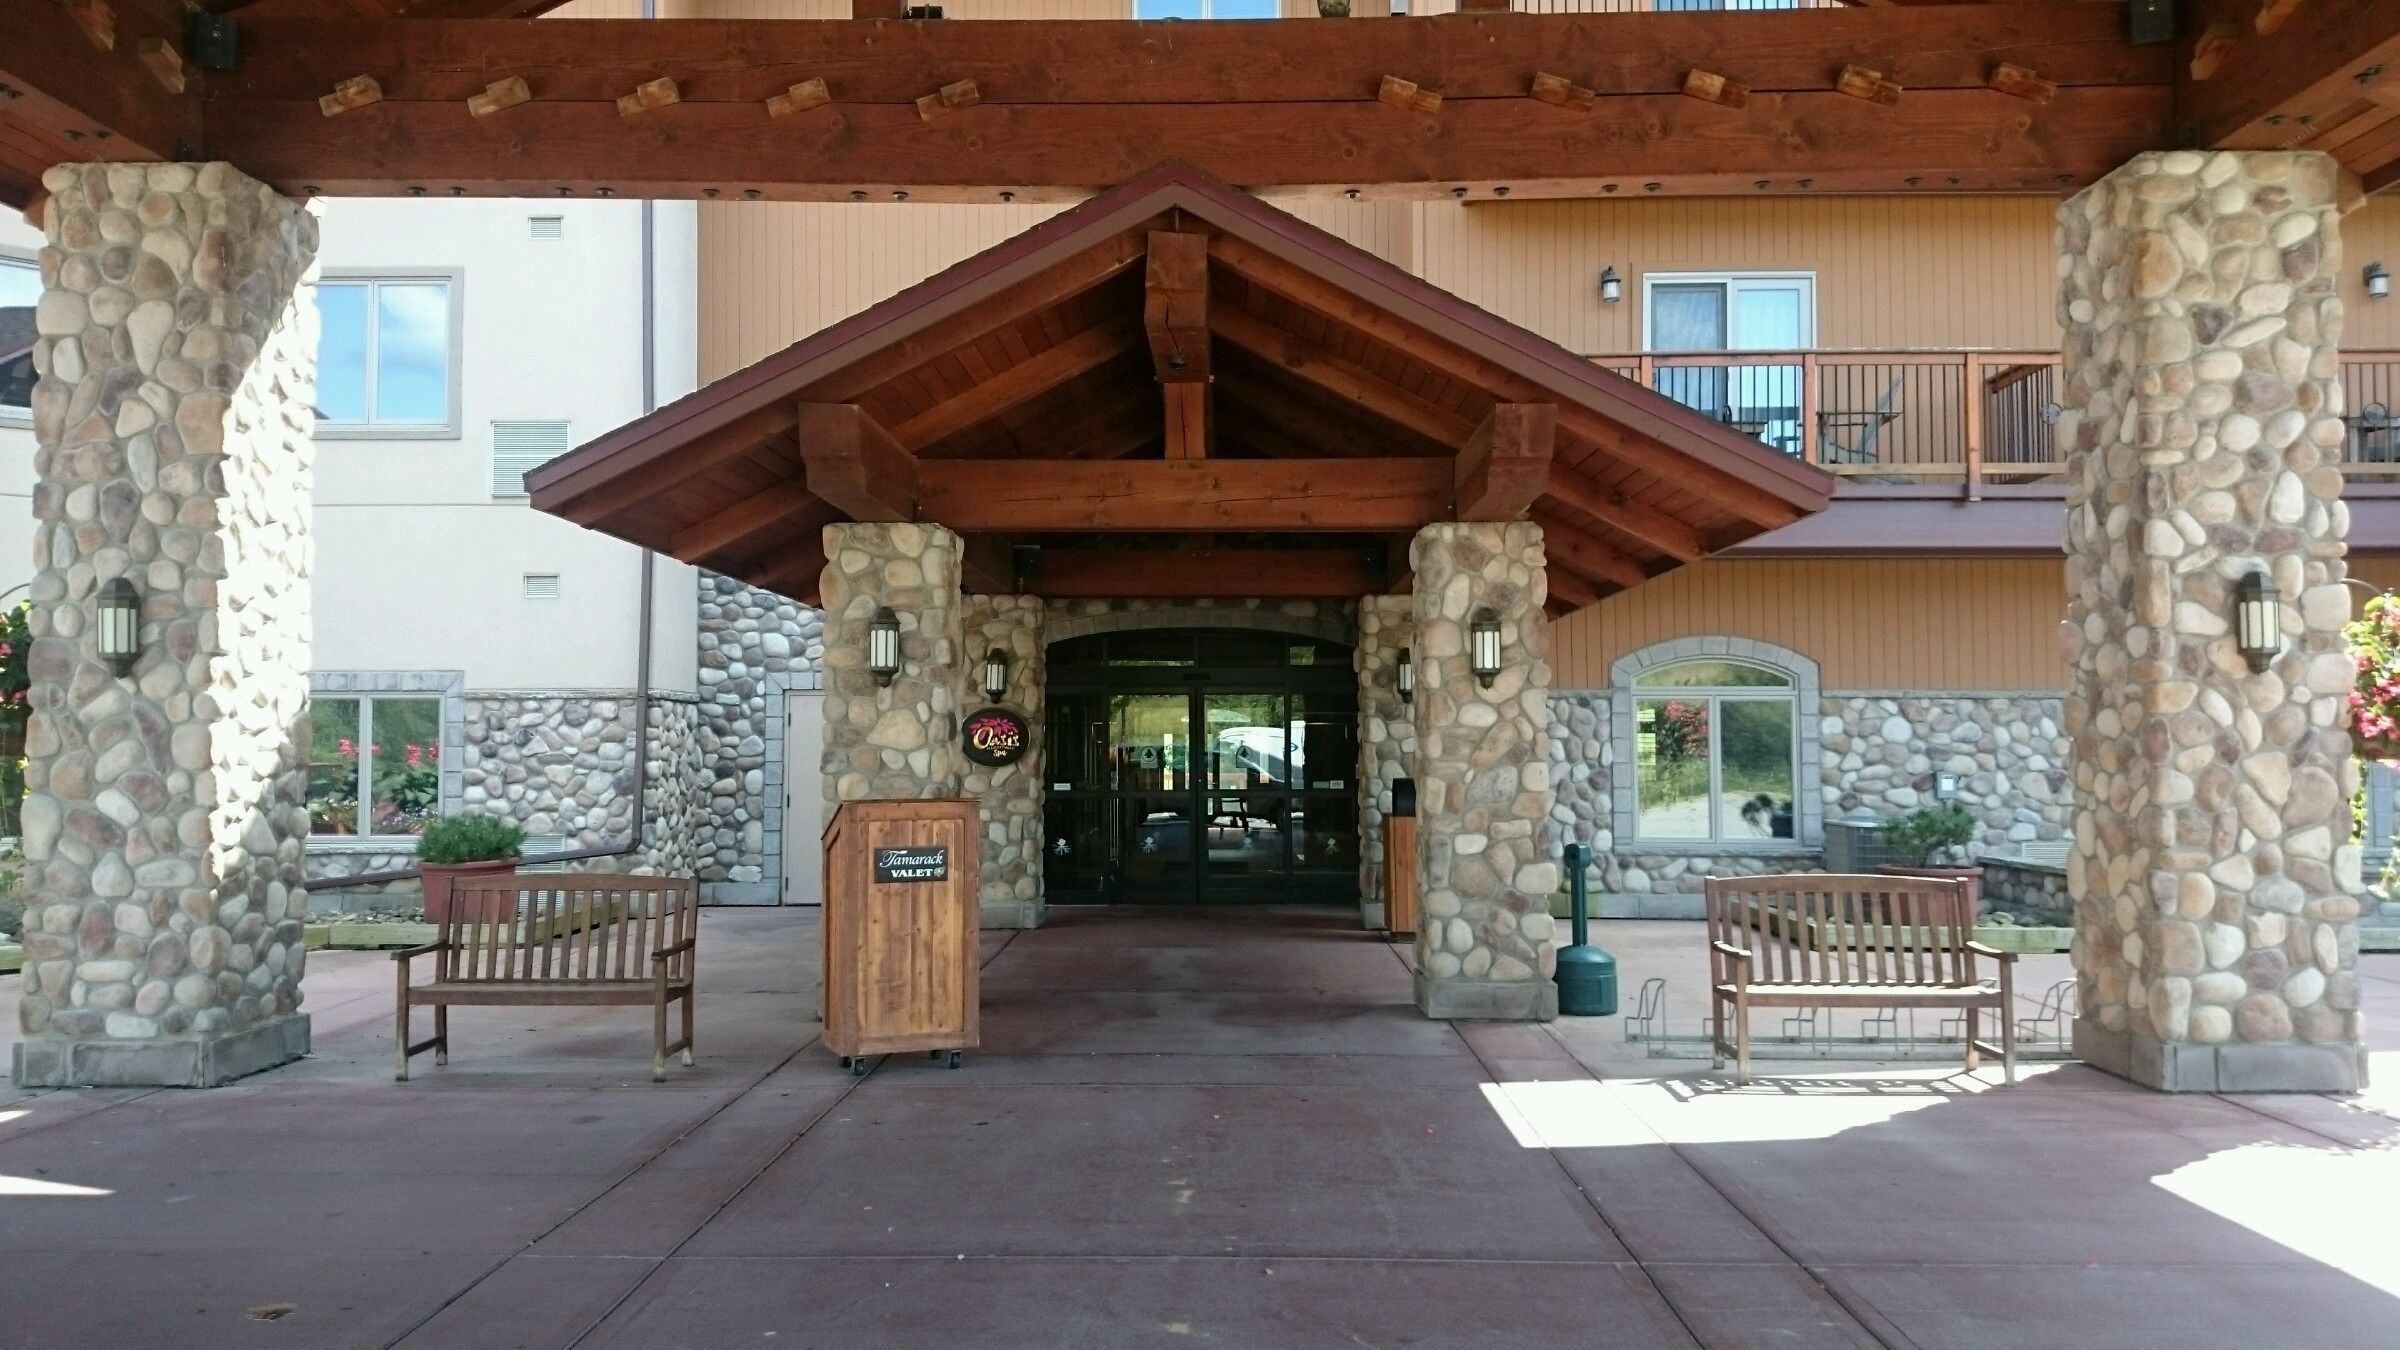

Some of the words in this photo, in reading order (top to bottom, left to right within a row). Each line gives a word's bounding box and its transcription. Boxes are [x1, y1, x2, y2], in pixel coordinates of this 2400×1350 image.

[974, 726, 1019, 749] Oasis
[879, 850, 944, 867] Tamarack
[891, 868, 933, 877] VALET
